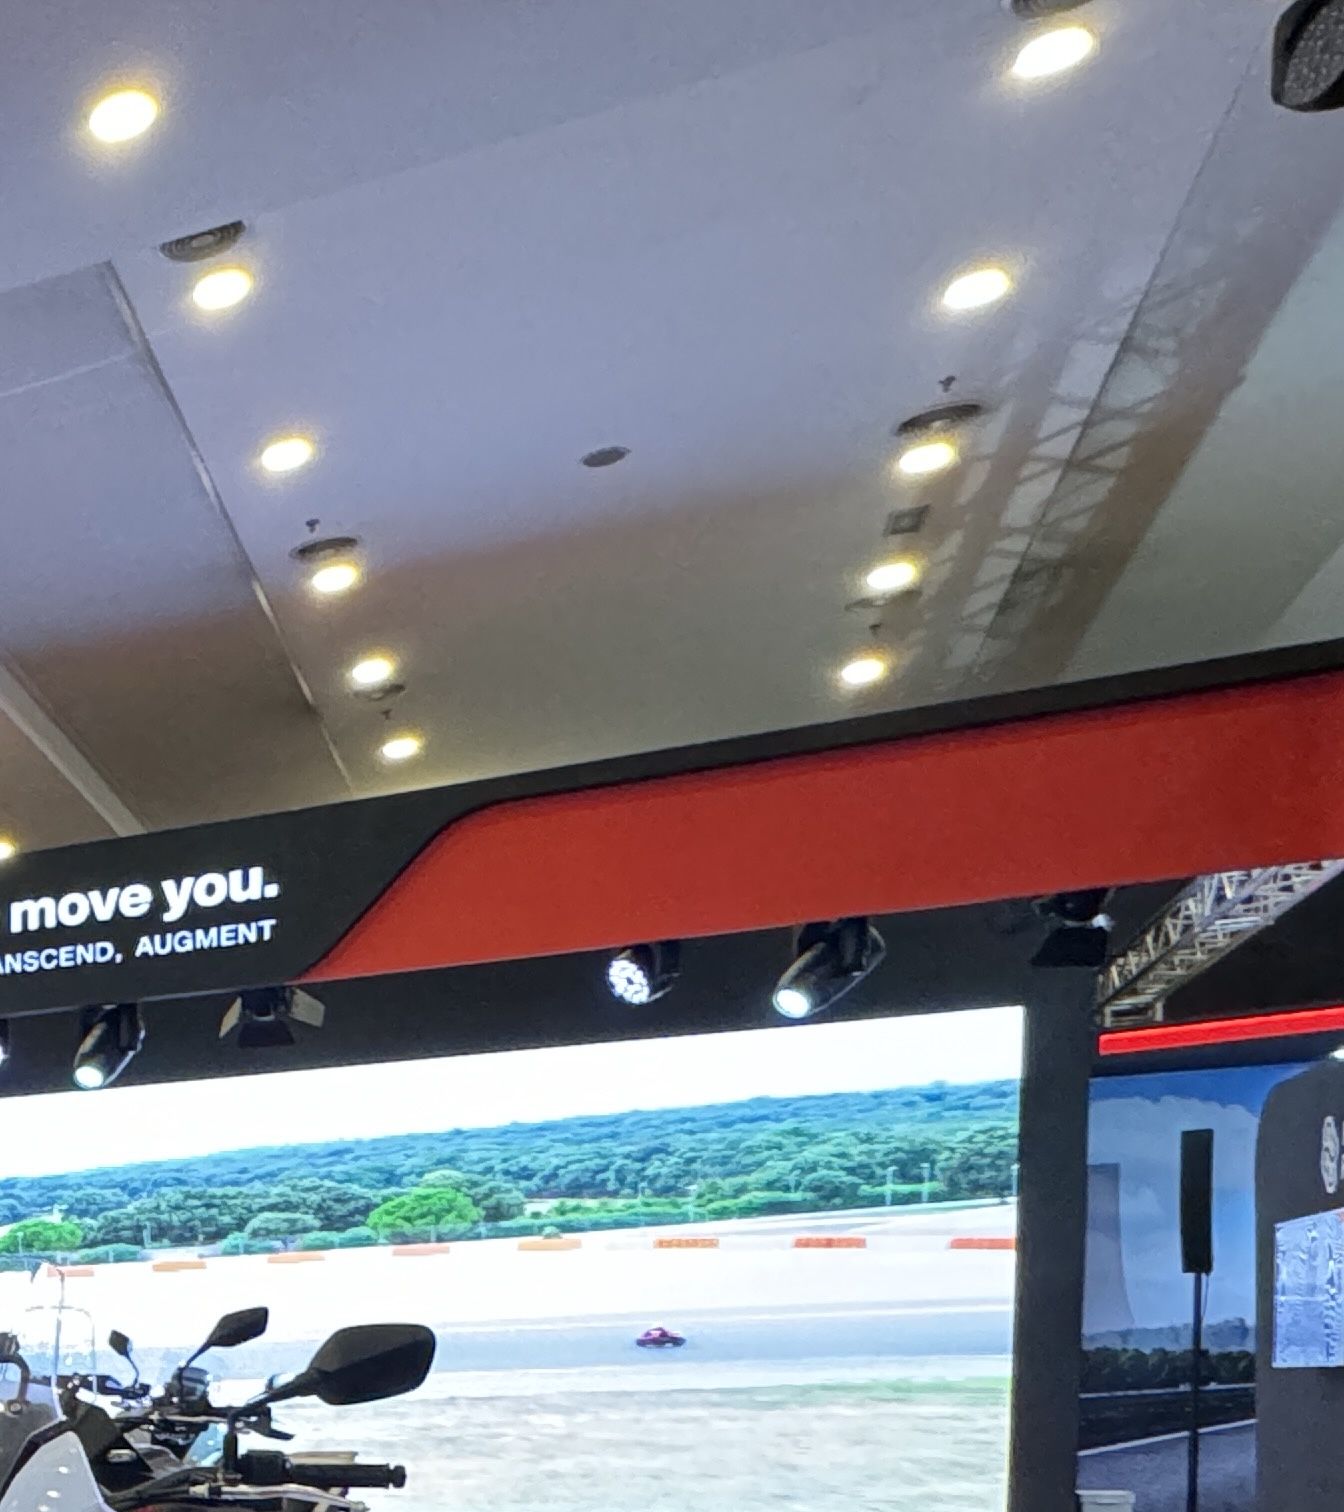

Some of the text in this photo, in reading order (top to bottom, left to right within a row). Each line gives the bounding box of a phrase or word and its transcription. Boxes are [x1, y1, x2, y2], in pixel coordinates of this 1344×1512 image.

[10, 881, 154, 934] move
[159, 865, 280, 923] you.
[134, 918, 278, 958] AUGMENT
